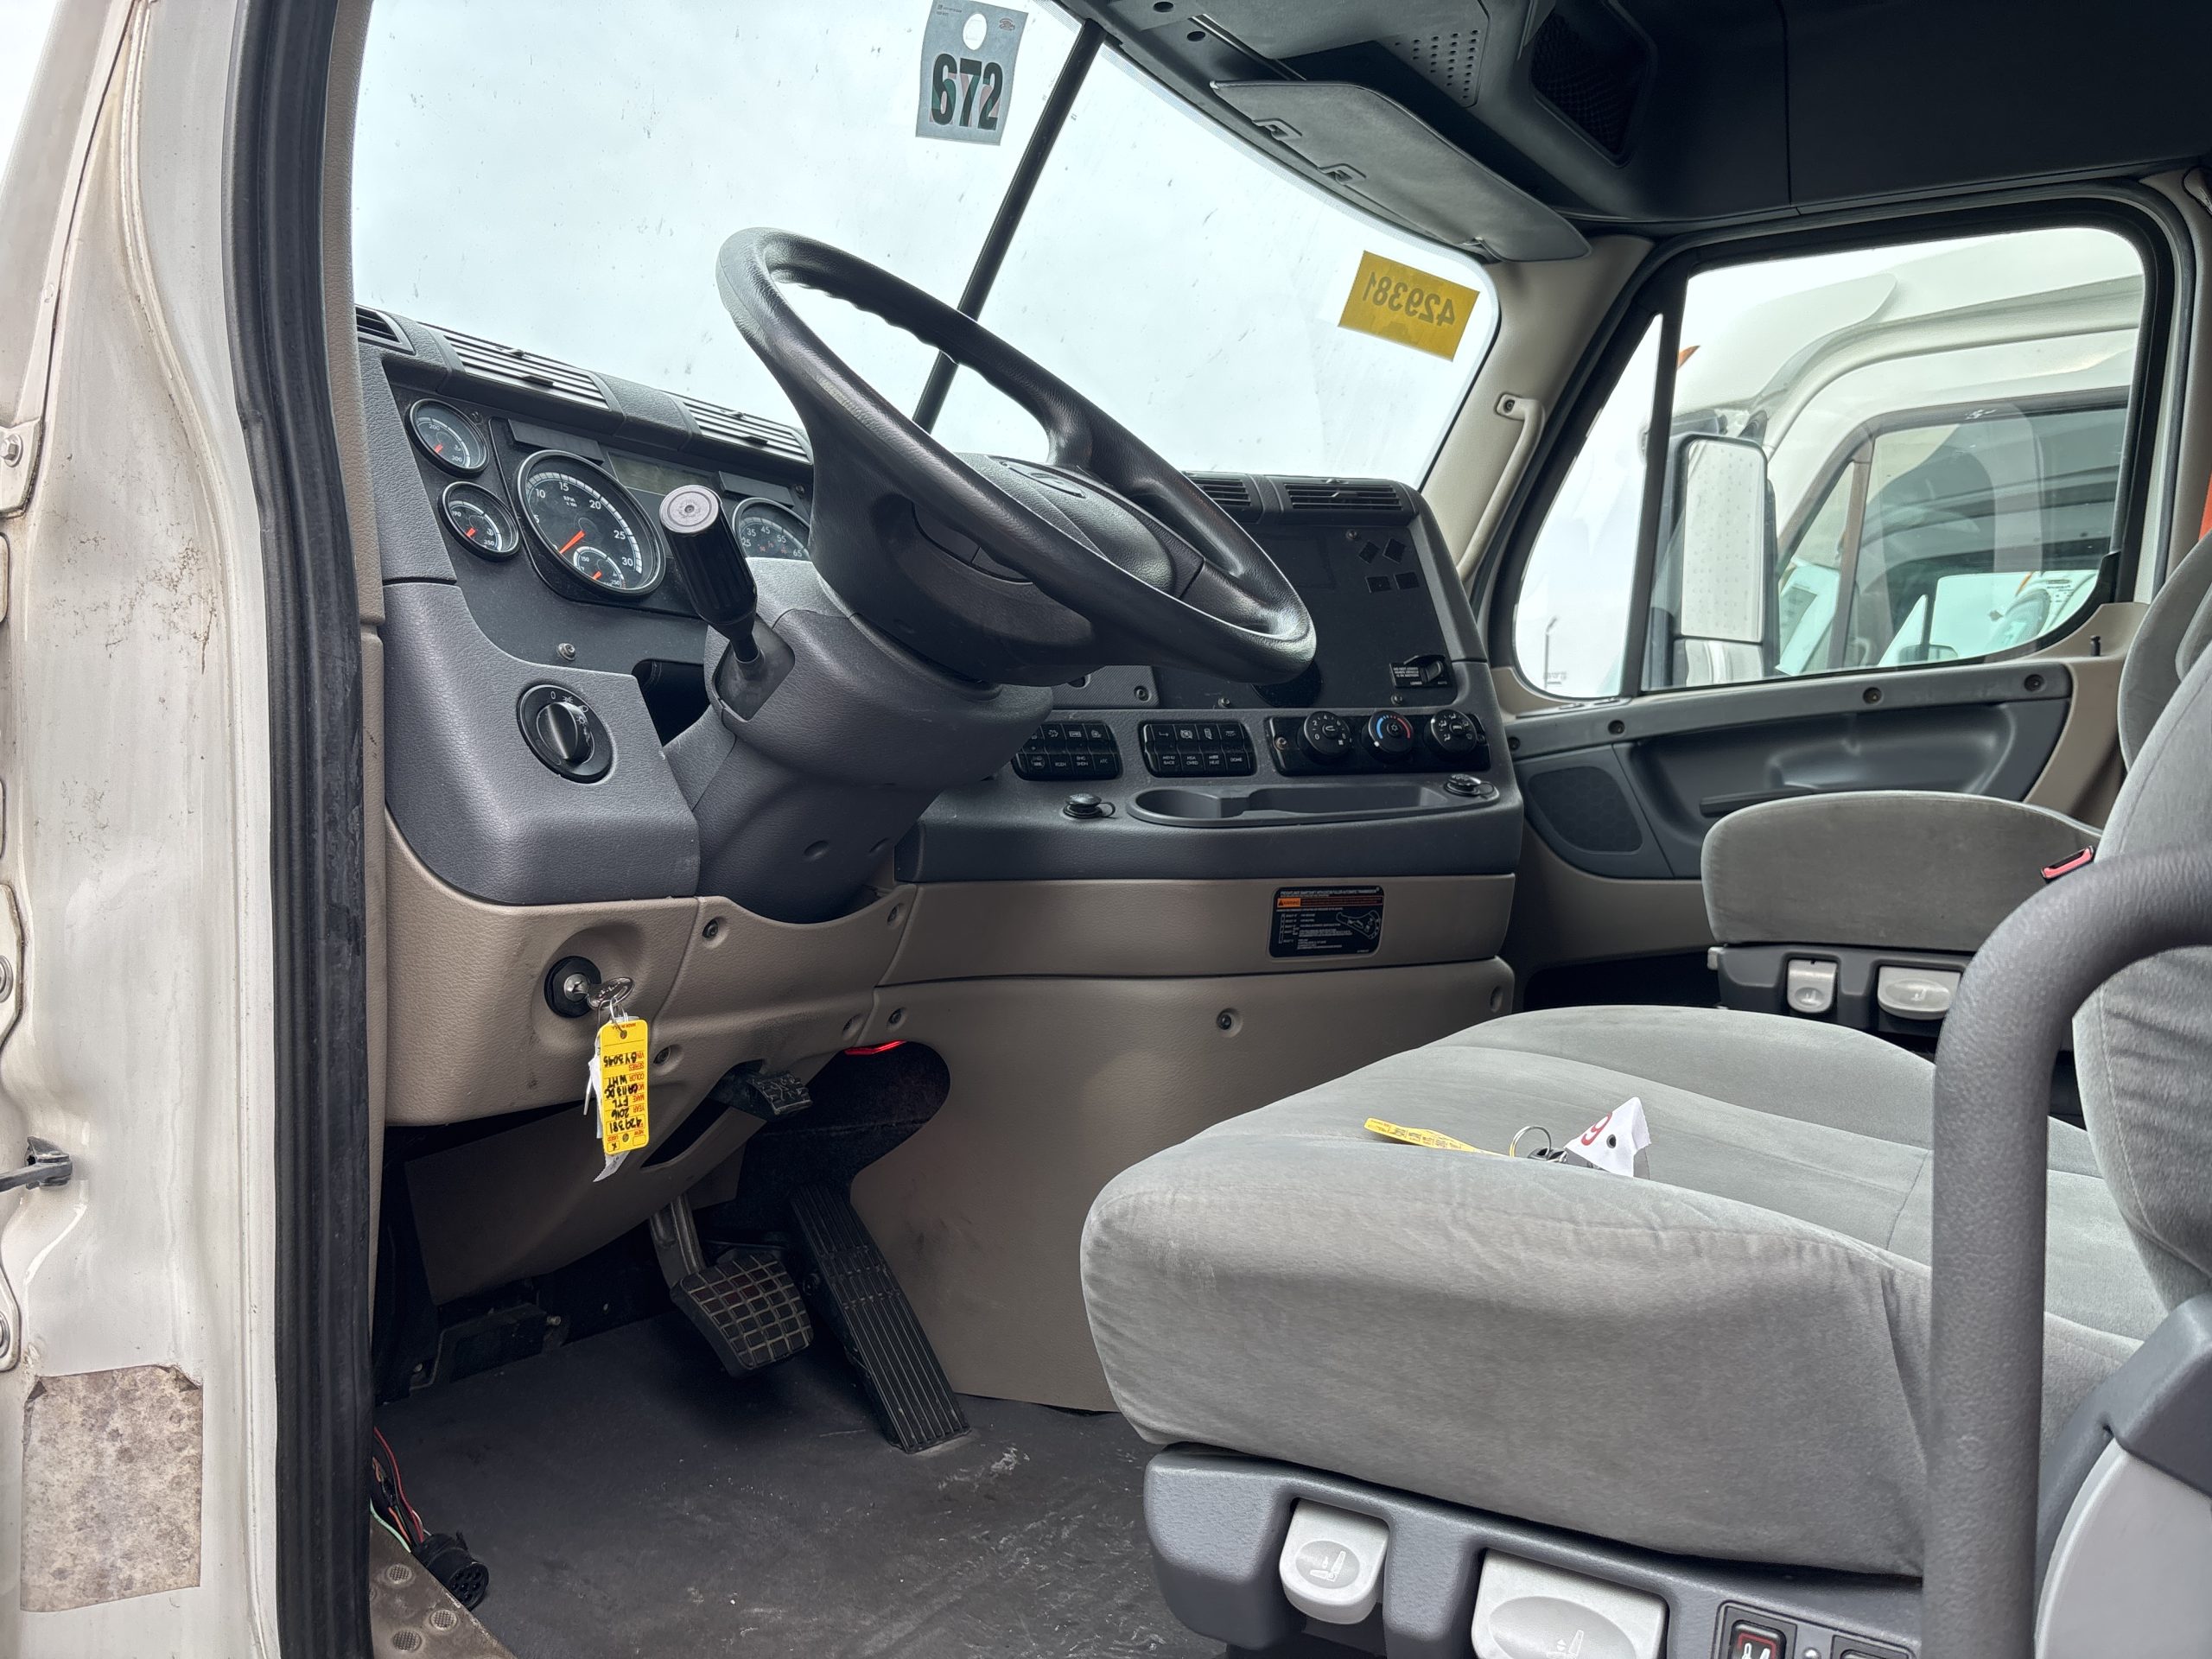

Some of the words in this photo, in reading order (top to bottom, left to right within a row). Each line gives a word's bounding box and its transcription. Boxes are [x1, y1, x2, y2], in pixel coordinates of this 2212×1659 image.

[931, 54, 1003, 130] 672
[558, 481, 569, 492] 15
[535, 488, 546, 499] 10
[588, 499, 601, 510] 20
[613, 530, 626, 540] 25
[747, 527, 757, 537] 35
[760, 525, 771, 535] 45
[777, 534, 786, 543] 55
[792, 549, 803, 557] 65
[621, 556, 633, 567] 30
[628, 1061, 645, 1071] SERIES
[608, 1074, 627, 1087] WHT
[629, 1072, 645, 1082] COLOR
[612, 1095, 629, 1109] FTL
[632, 1094, 645, 1103] MAKE
[632, 1104, 645, 1113] YEAR
[609, 1116, 642, 1135] 429381
